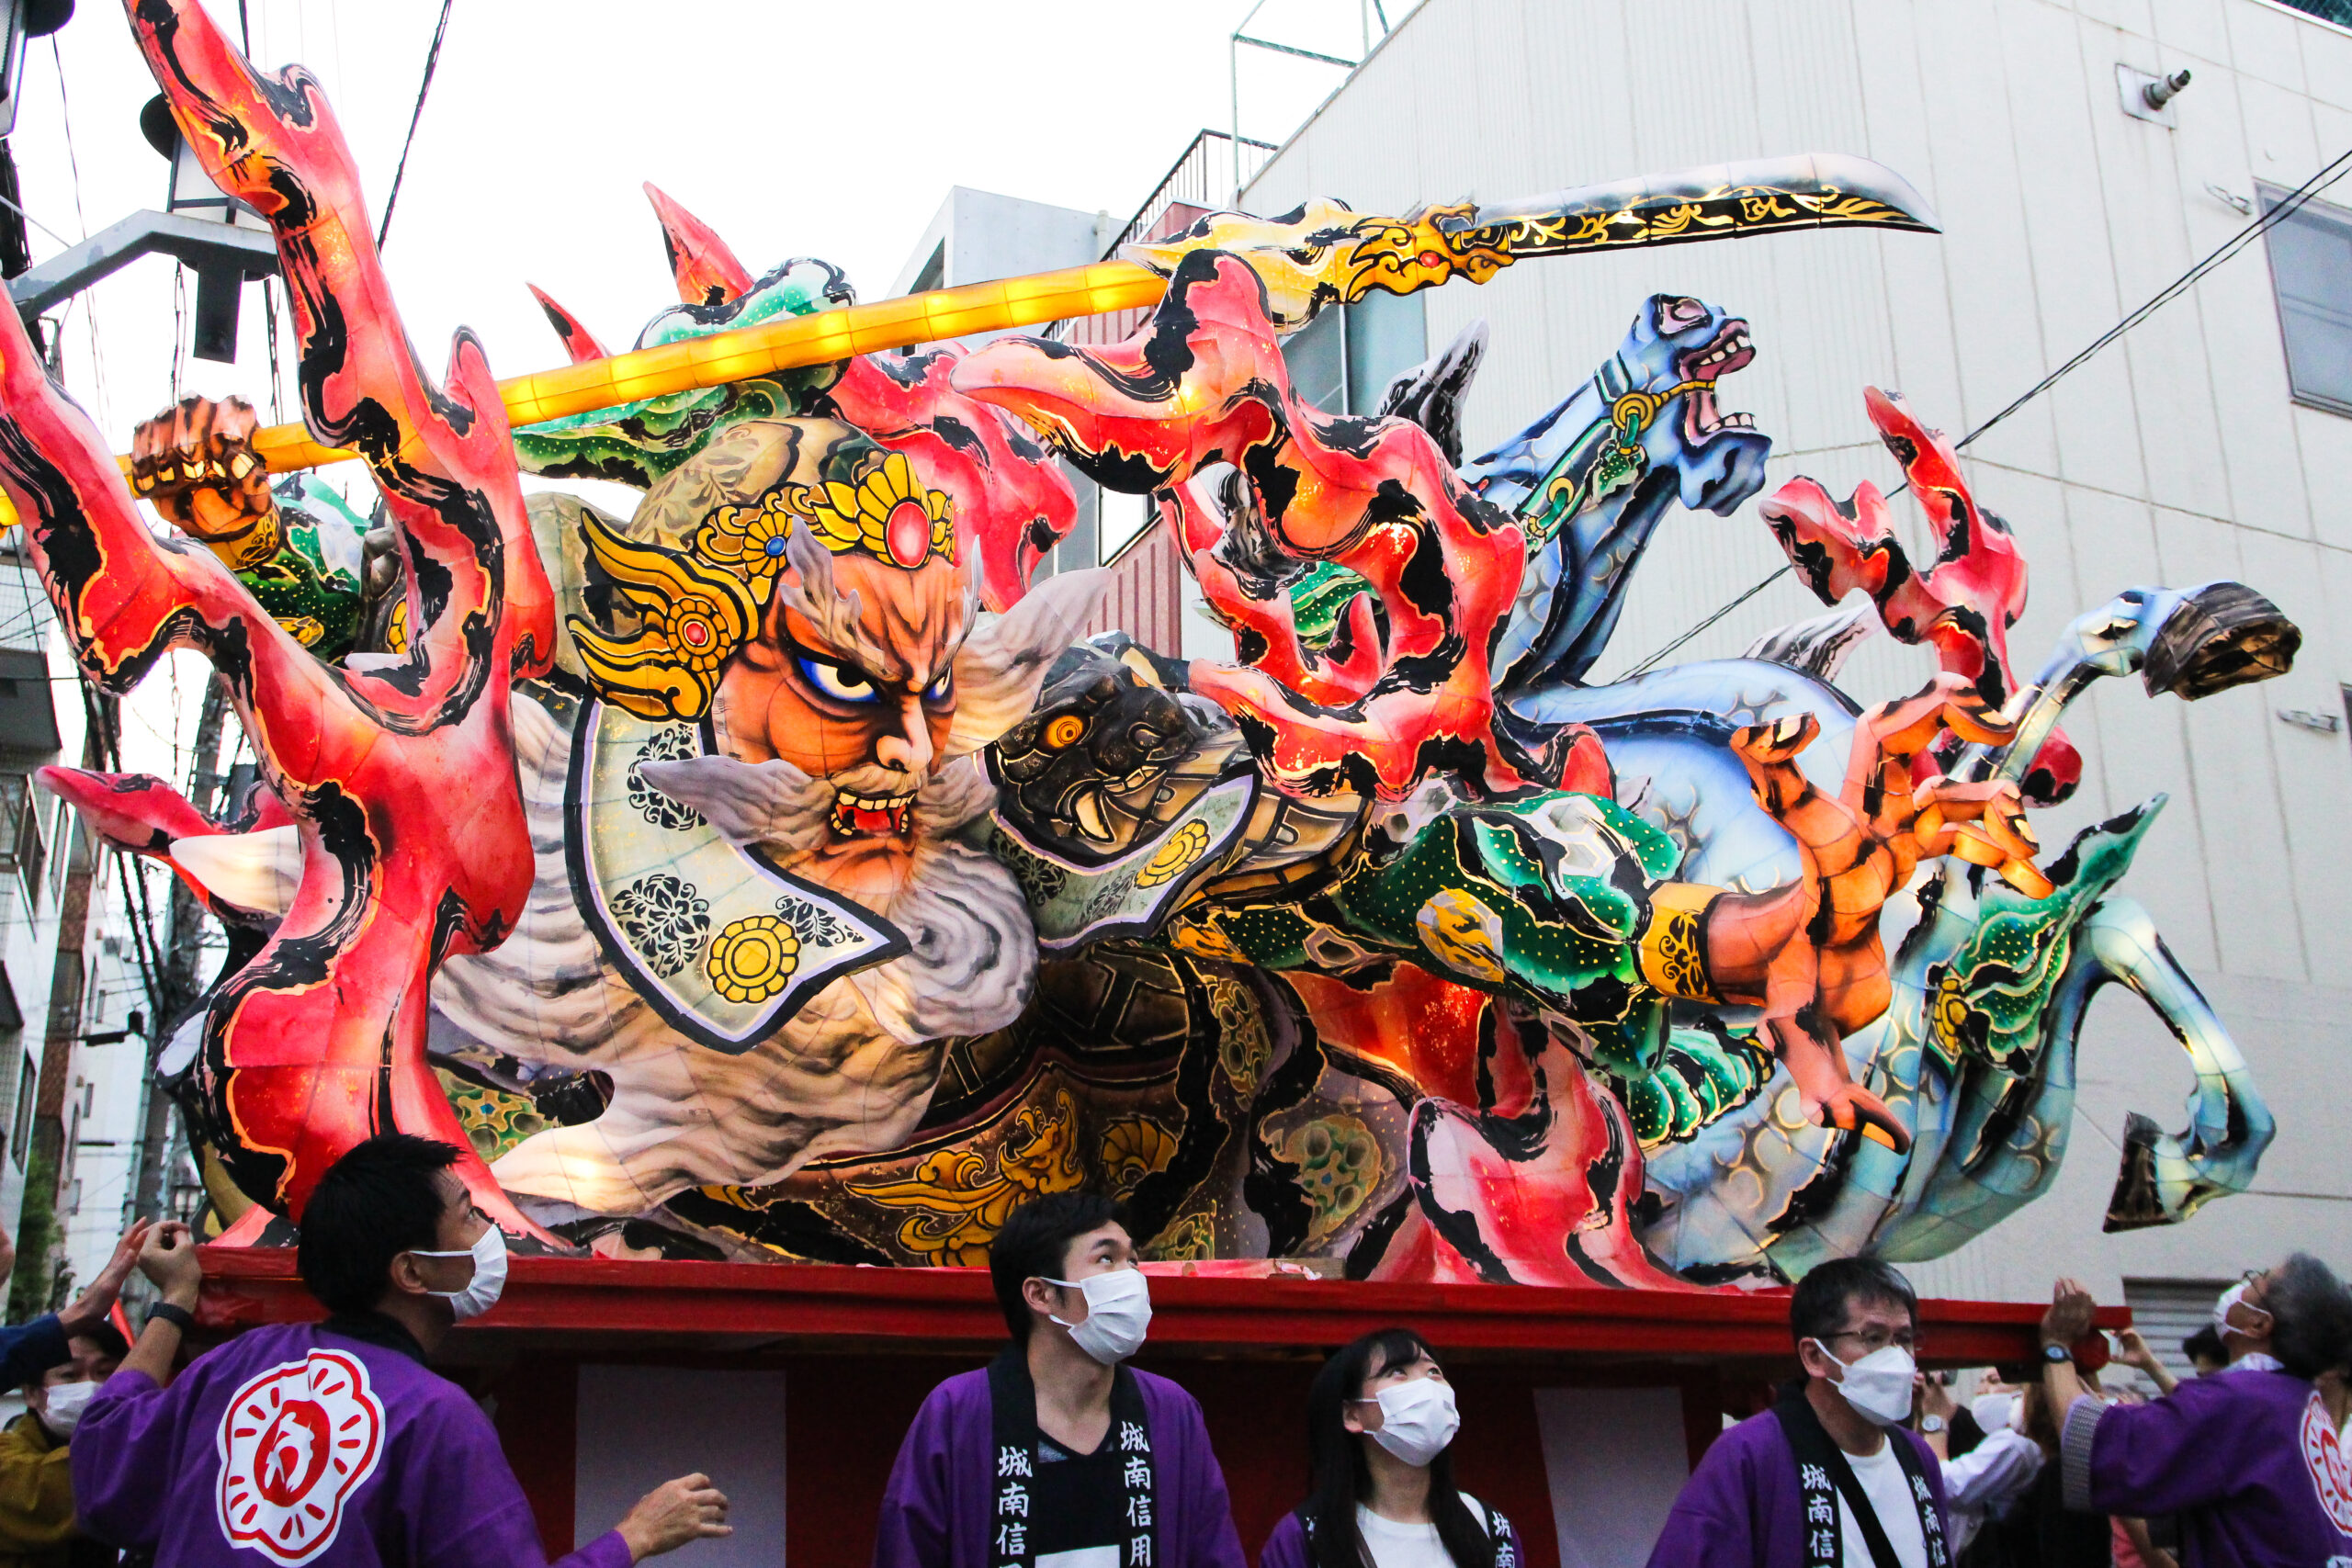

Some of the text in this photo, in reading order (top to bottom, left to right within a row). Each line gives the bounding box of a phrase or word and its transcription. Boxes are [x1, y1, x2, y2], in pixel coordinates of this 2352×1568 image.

[995, 1445, 1034, 1568] 城南信
[1119, 1420, 1152, 1568] 城南信用
[1801, 1462, 1836, 1568] 城南信
